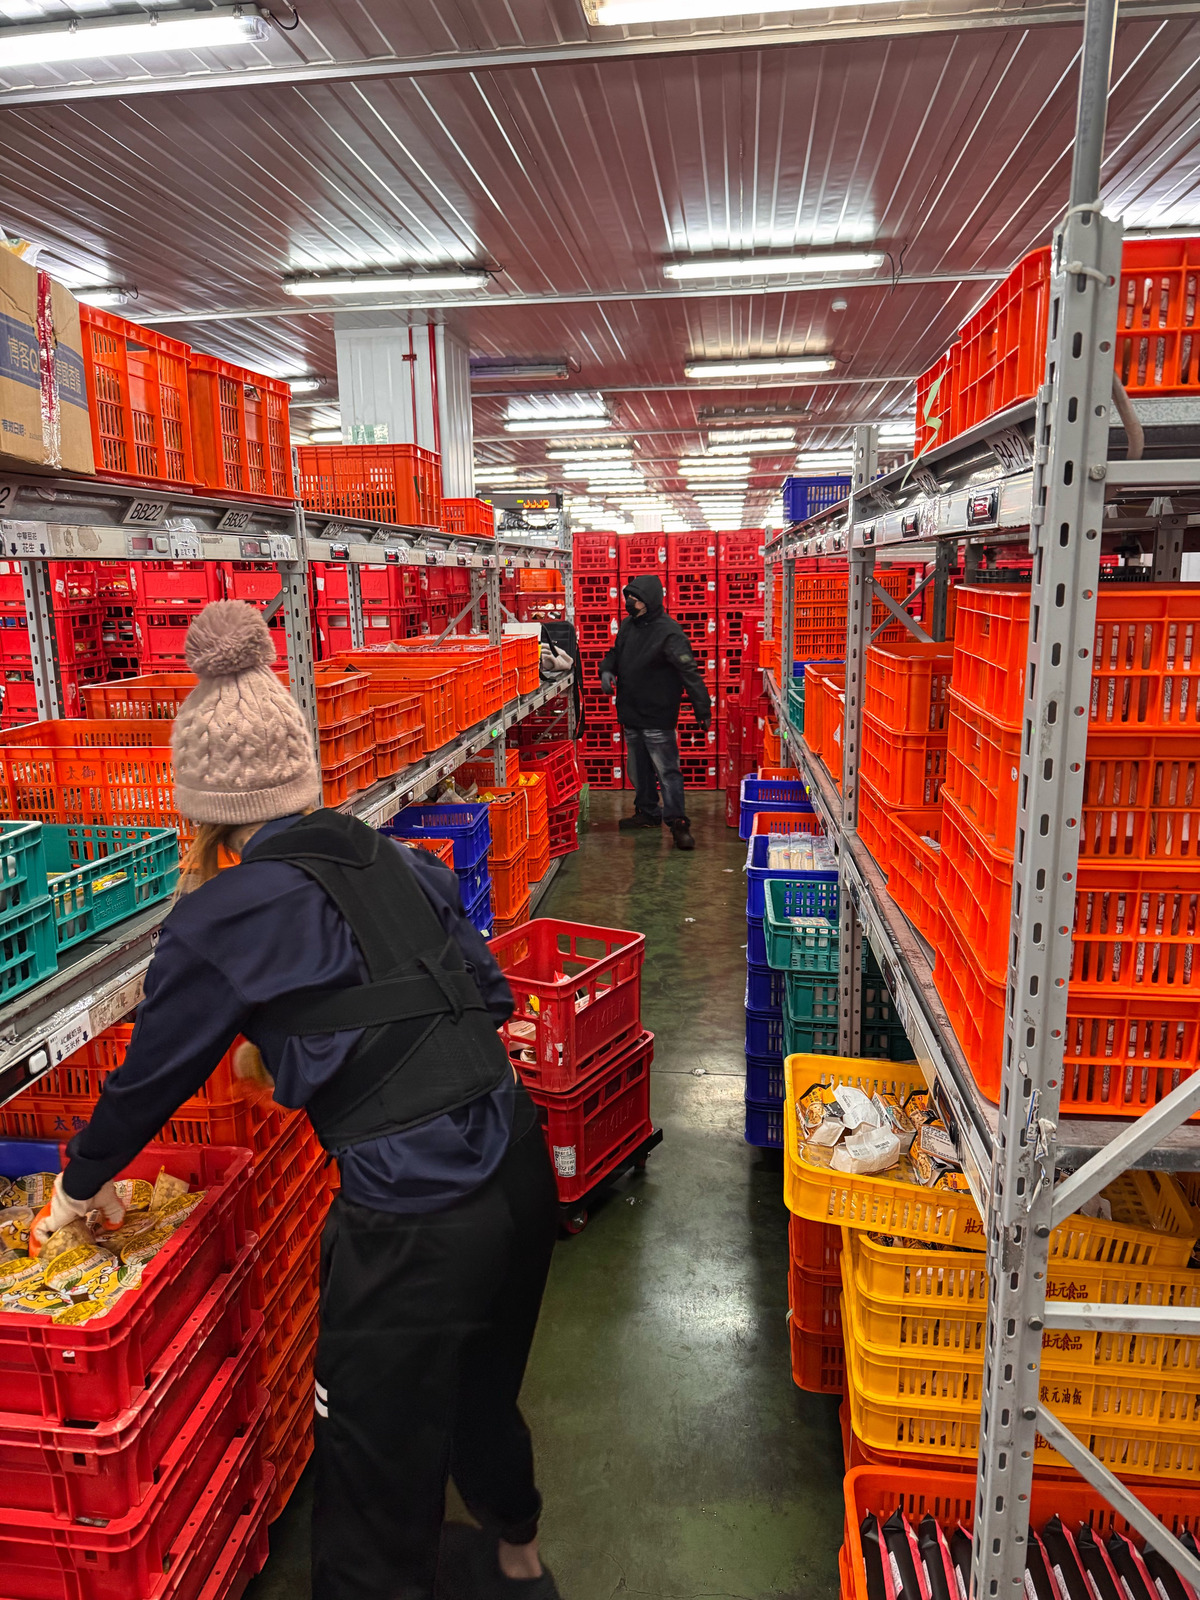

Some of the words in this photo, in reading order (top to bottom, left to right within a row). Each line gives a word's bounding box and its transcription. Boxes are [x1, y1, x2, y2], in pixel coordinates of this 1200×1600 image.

[993, 434, 1030, 469] BA12
[130, 502, 164, 521] BB22
[222, 511, 249, 528] BB32
[1045, 1280, 1089, 1300] 壯元食品
[1041, 1332, 1083, 1351] 壯元食品
